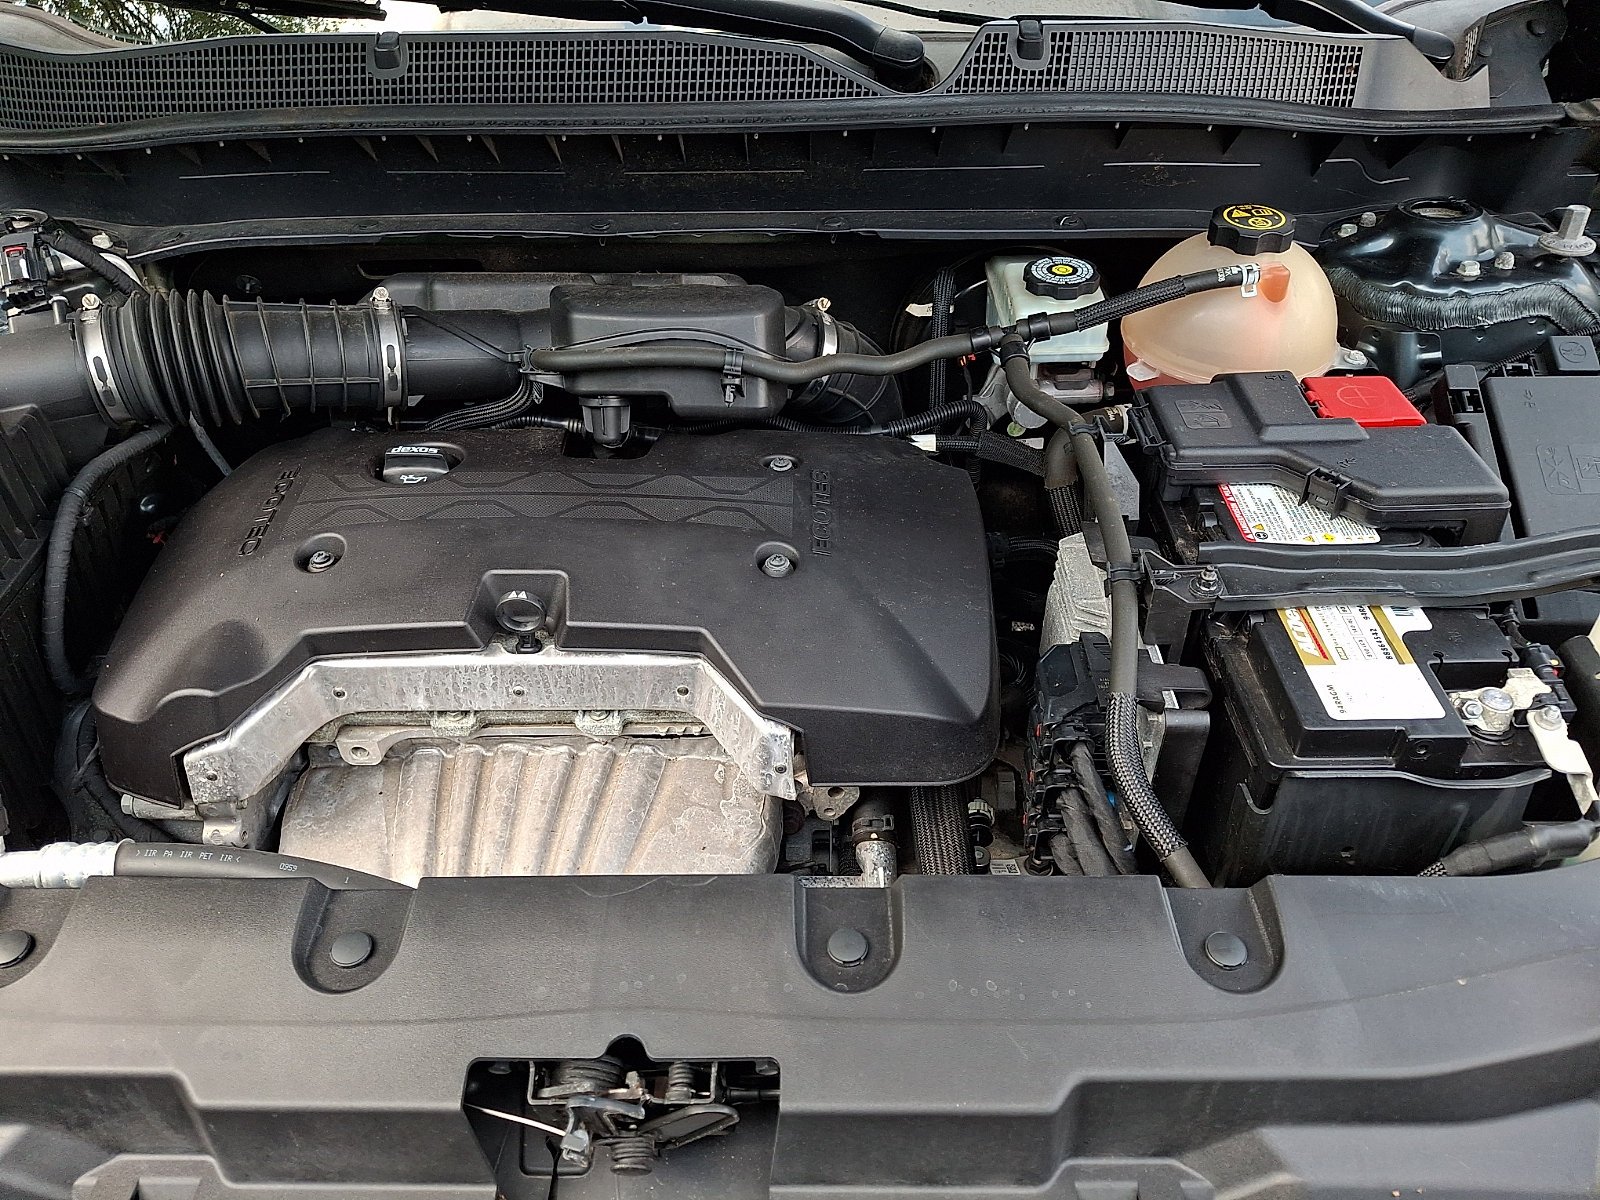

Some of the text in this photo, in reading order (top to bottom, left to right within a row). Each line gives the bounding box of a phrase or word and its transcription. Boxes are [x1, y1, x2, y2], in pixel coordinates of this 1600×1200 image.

[390, 445, 441, 454] dexos
[811, 469, 832, 556] ECOTEC
[163, 850, 173, 858] PA
[198, 852, 214, 861] PET
